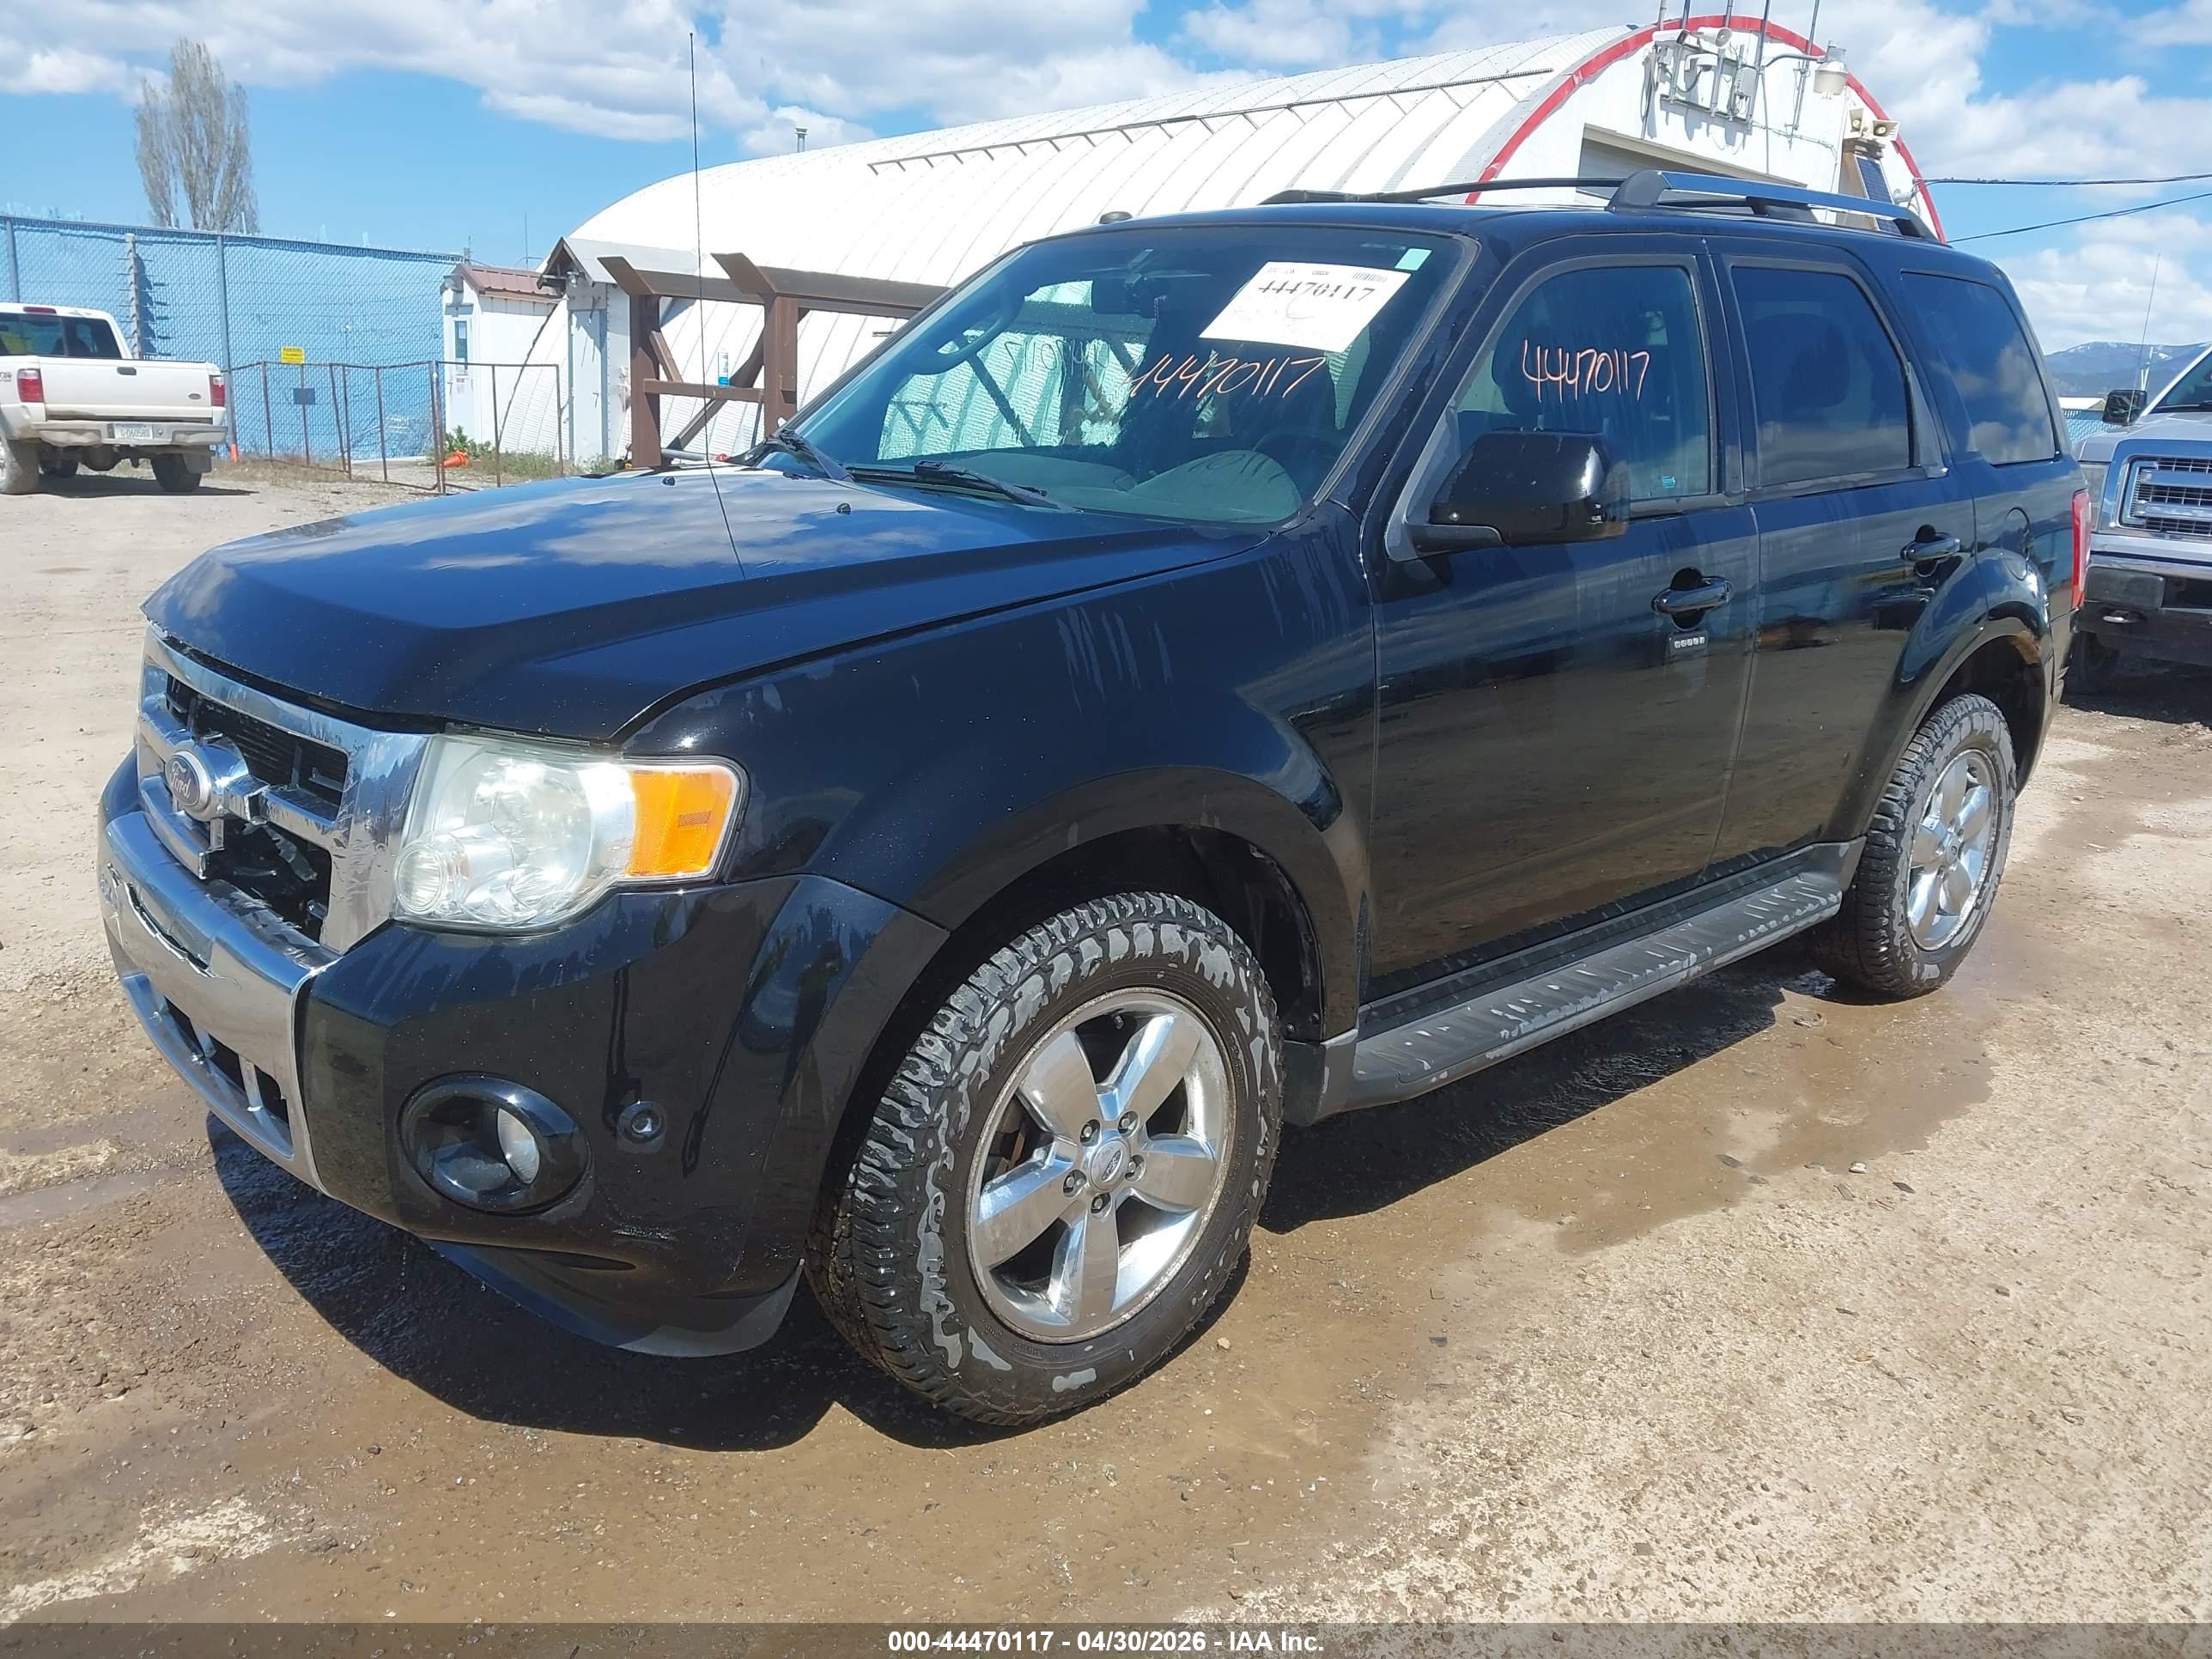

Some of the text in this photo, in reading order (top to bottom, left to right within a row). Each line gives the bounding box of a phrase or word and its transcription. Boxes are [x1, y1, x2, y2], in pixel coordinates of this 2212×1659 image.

[1258, 280, 1376, 301] 44470117
[1124, 353, 1327, 399] 44470117
[1522, 339, 1650, 404] 44470117
[171, 760, 191, 799] Ford
